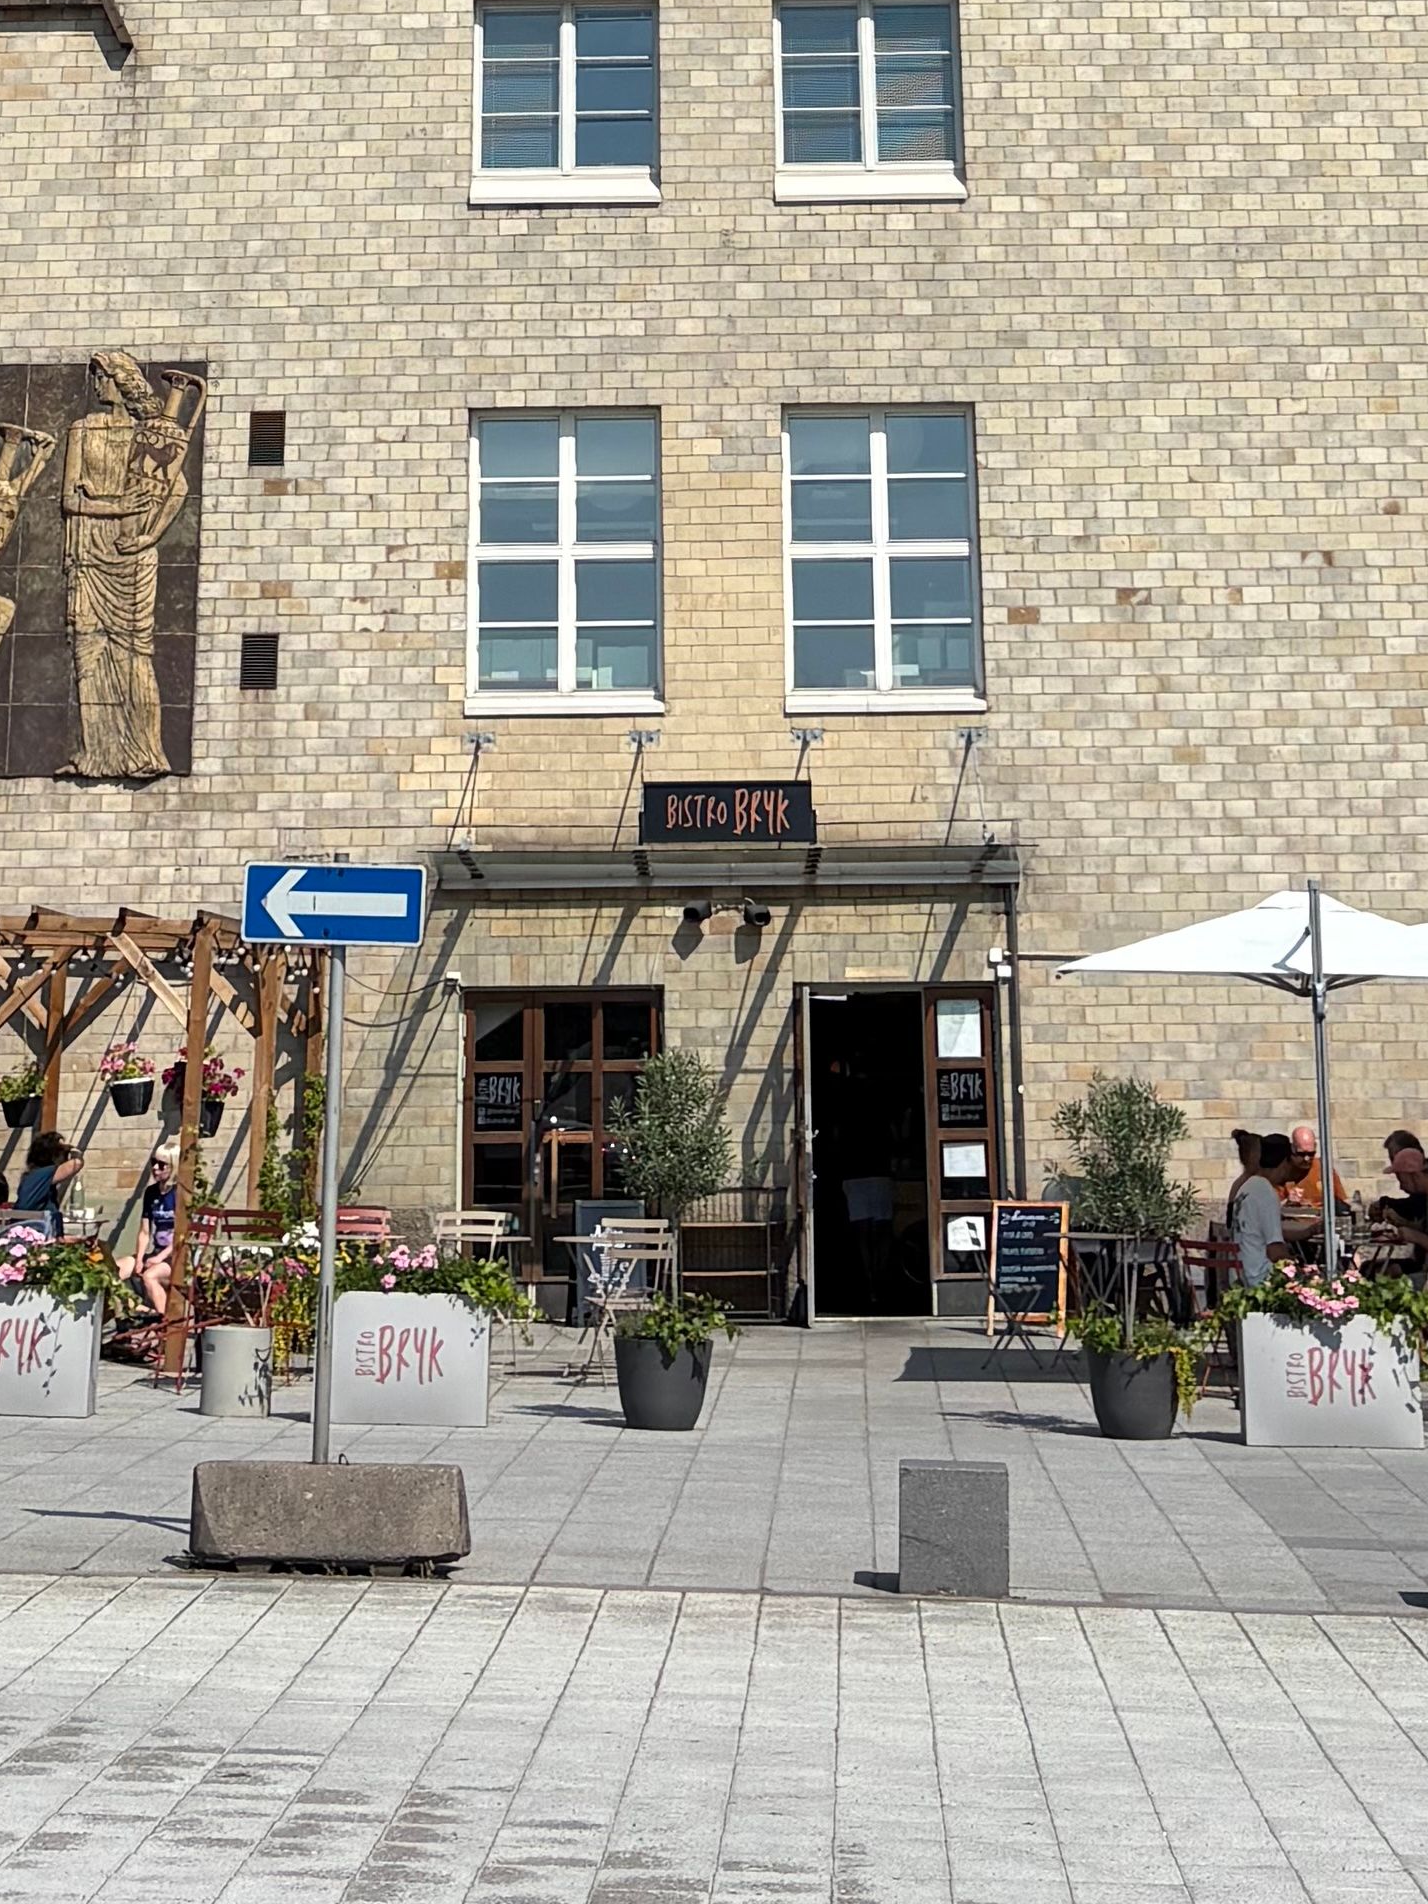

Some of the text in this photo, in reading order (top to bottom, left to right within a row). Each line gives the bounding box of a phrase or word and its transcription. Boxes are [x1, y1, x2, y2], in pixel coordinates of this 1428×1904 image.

[666, 788, 790, 835] BISTRO BRYK
[488, 1076, 521, 1105] BRYK
[950, 1072, 983, 1100] BRYK
[355, 1324, 445, 1385] BISTRO BRYK
[1286, 1347, 1377, 1407] BISTRO BRYK
